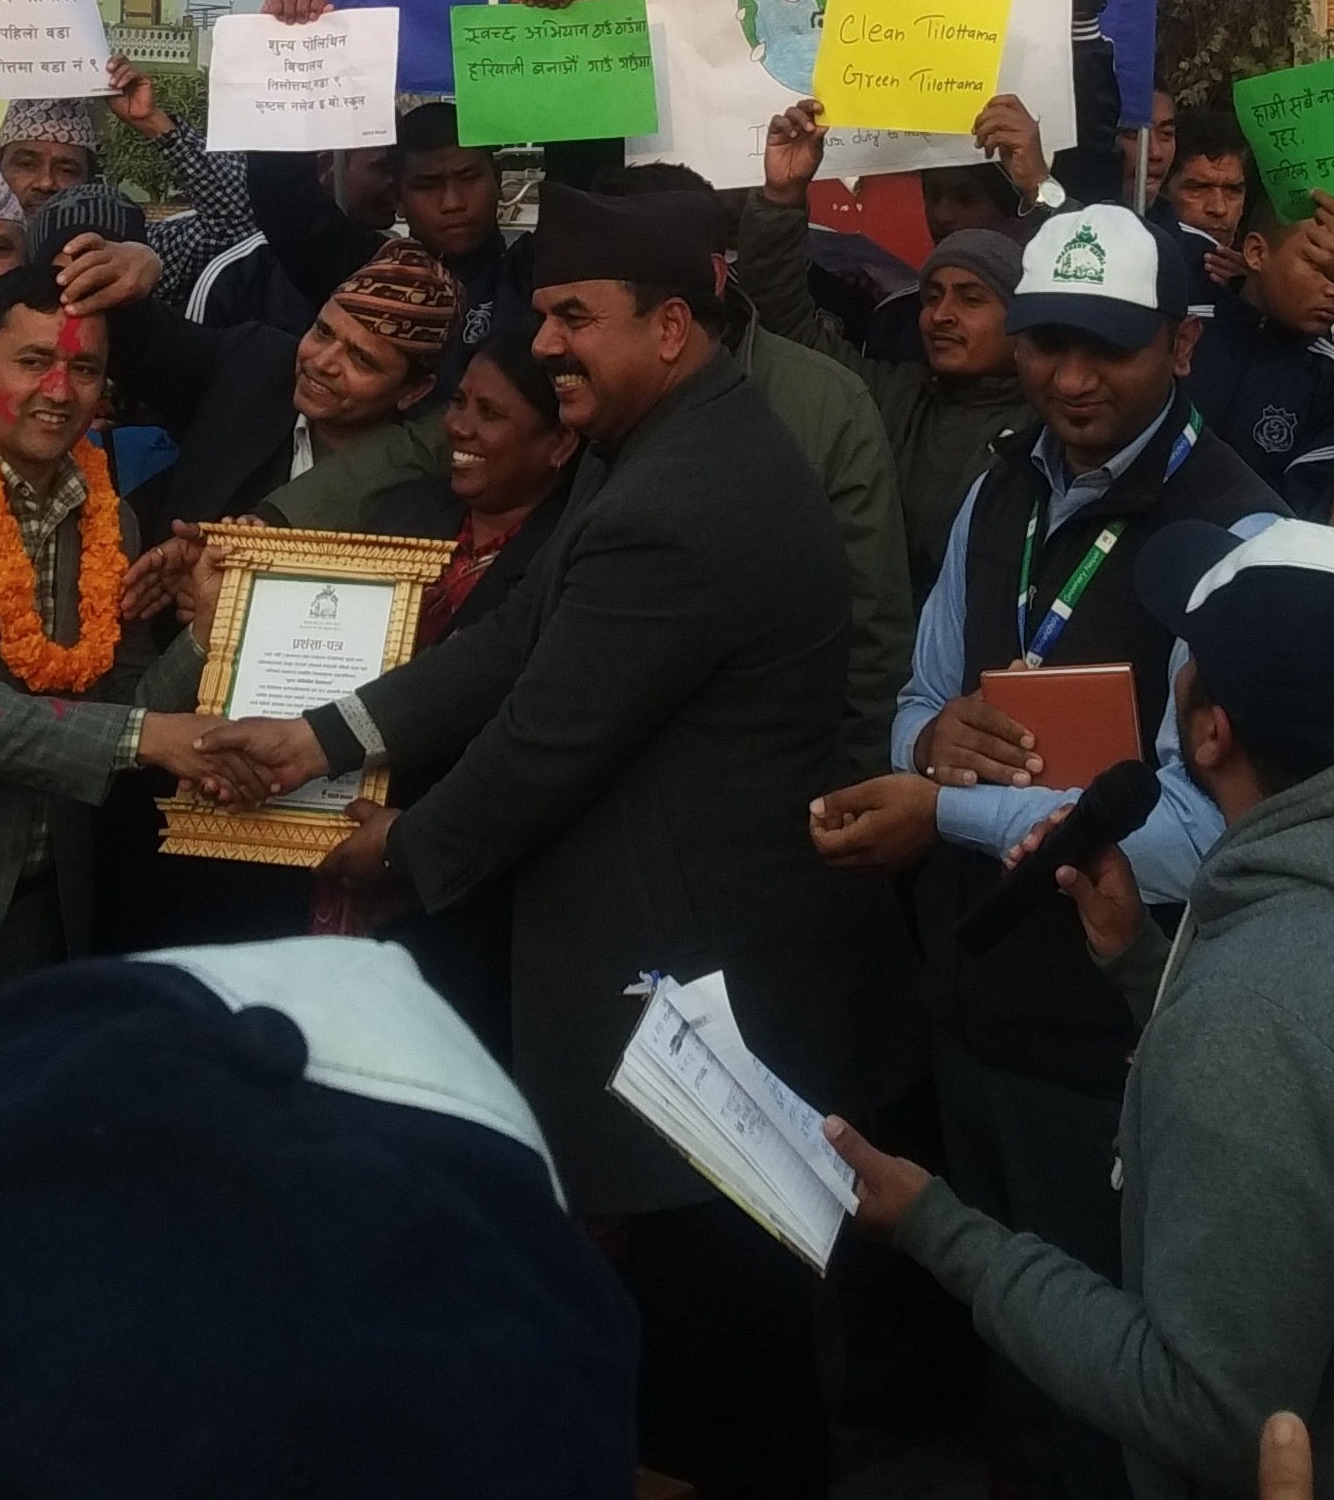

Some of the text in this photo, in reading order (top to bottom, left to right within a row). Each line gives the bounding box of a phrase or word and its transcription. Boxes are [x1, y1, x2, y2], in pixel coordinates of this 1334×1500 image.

[0, 24, 71, 41] पहिलो वडा
[525, 19, 589, 40] अभियान
[839, 14, 998, 45] Clean Tilottama
[40, 61, 66, 73] वडा
[284, 57, 324, 73] विद्यालय
[468, 55, 525, 81] हरियाली
[842, 63, 984, 94] Green Tilottama
[1251, 92, 1287, 127] हामी
[852, 128, 881, 147] duty
